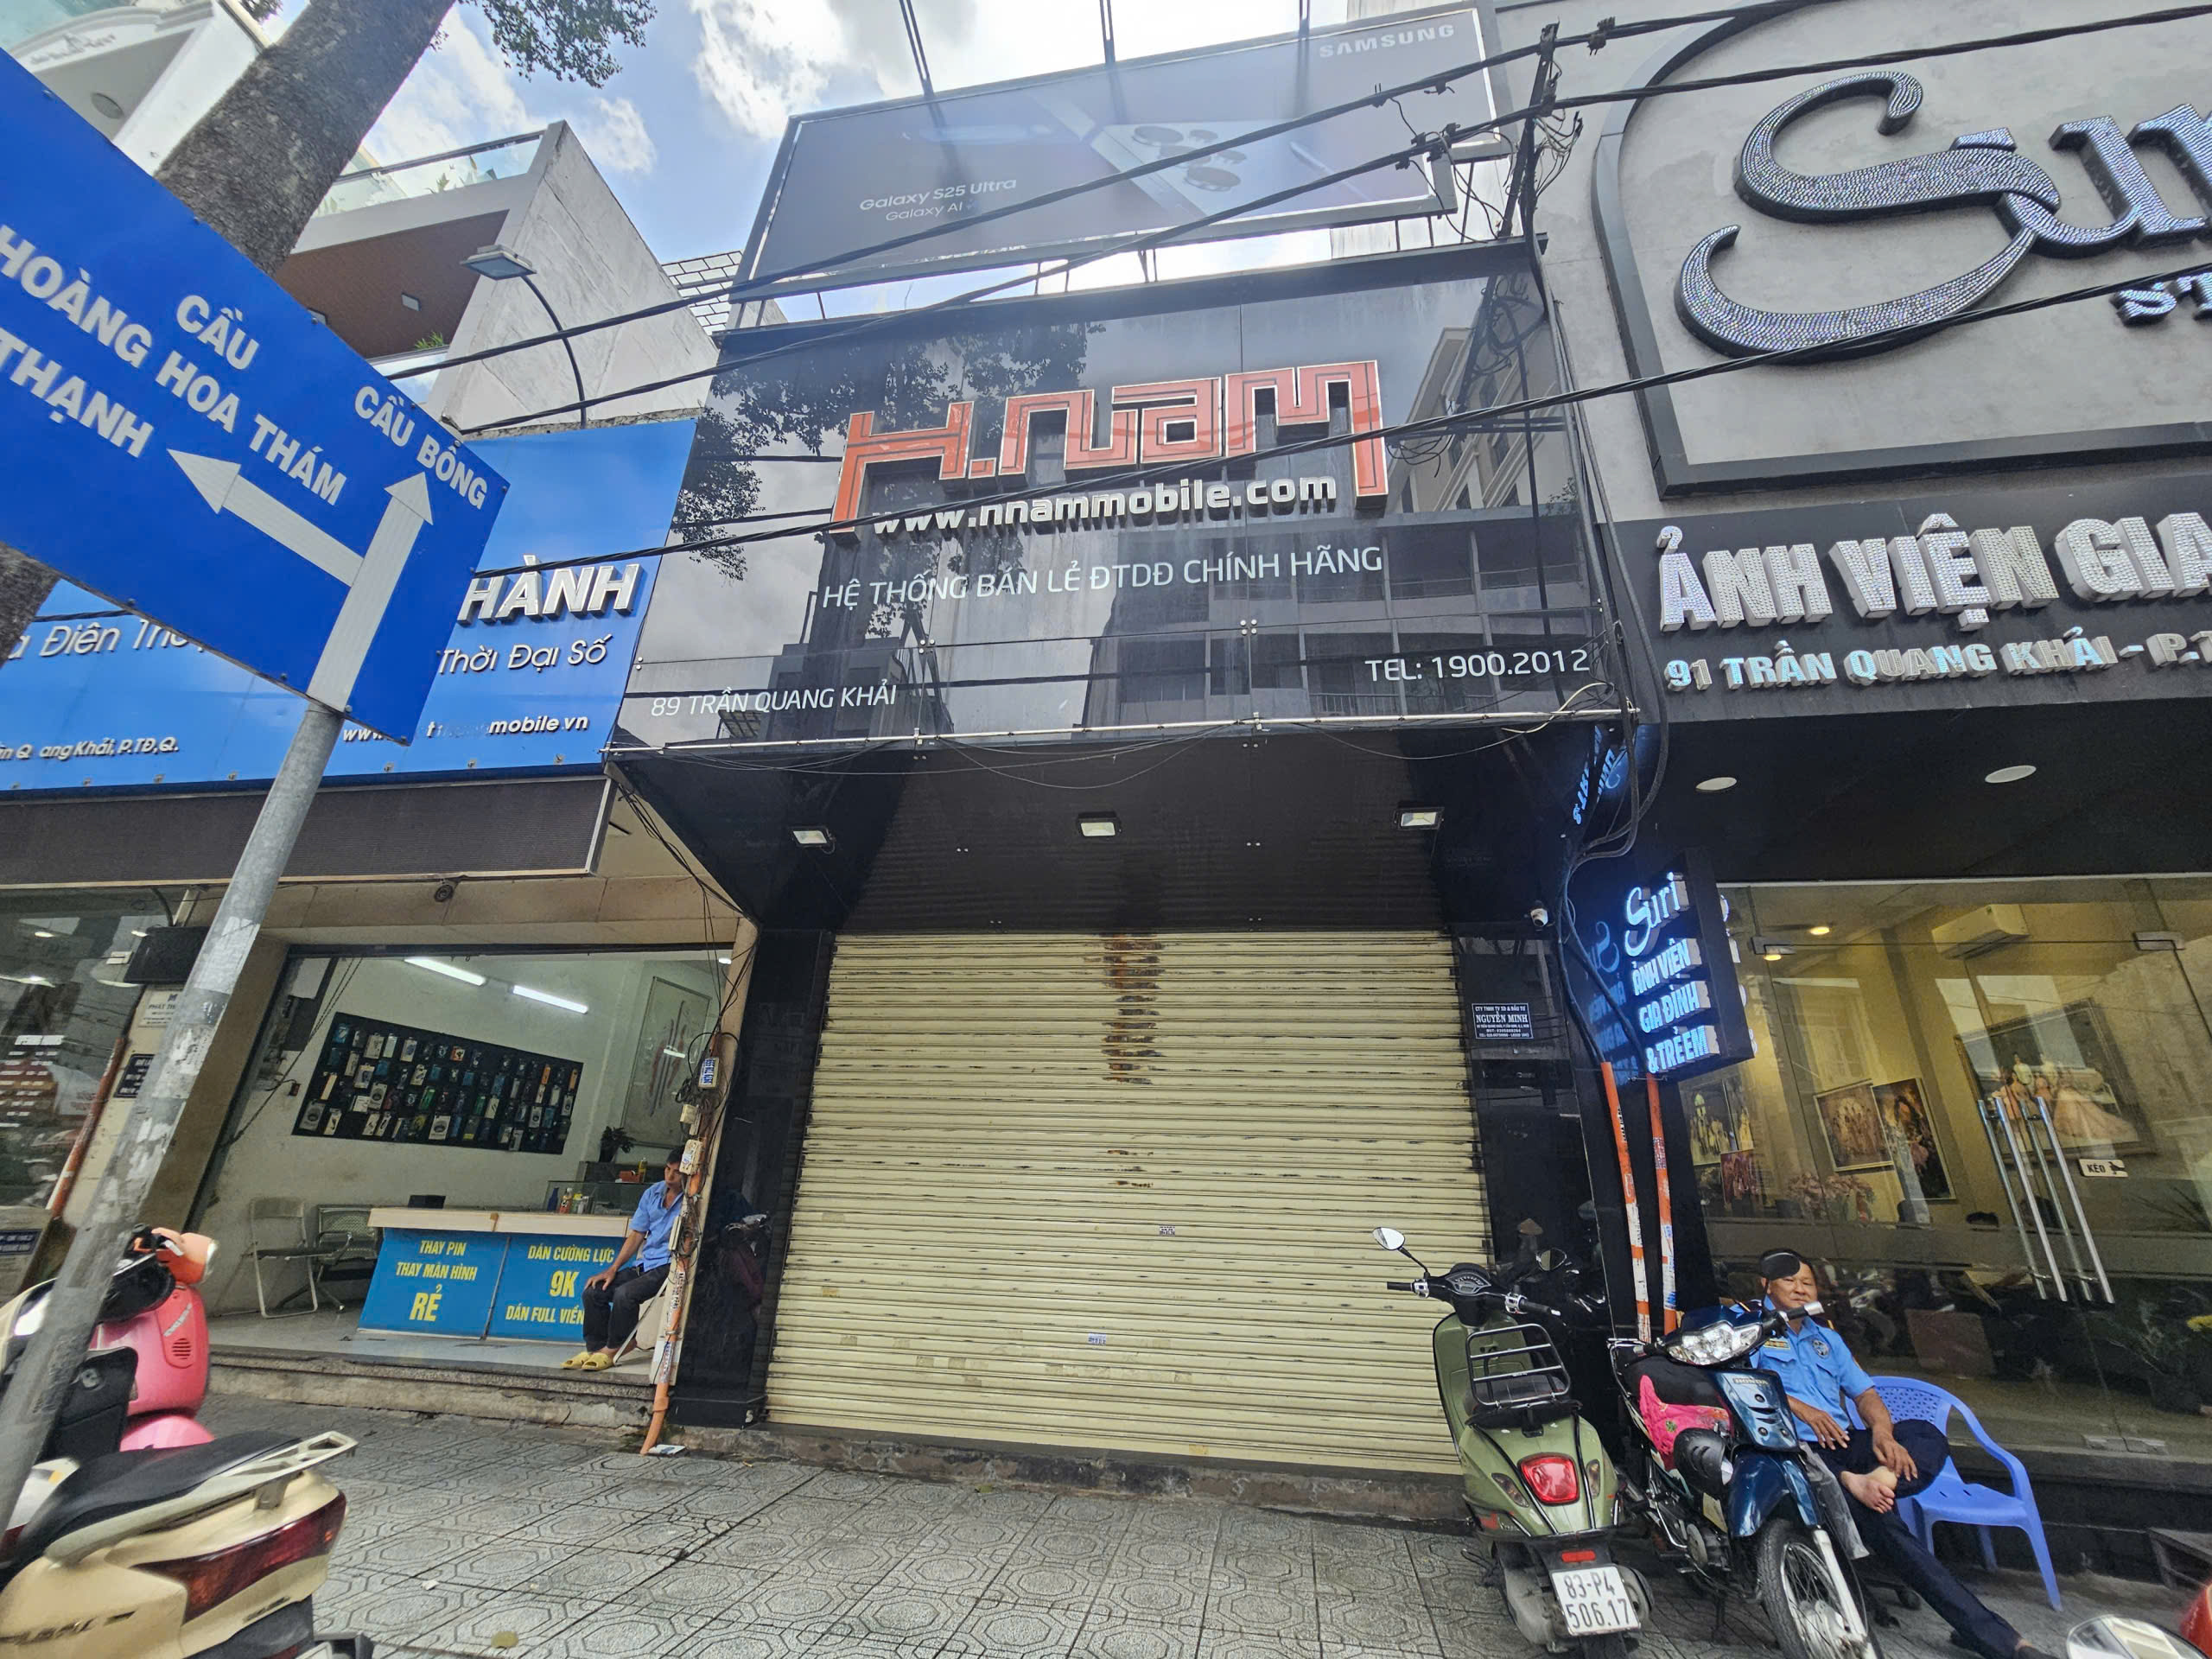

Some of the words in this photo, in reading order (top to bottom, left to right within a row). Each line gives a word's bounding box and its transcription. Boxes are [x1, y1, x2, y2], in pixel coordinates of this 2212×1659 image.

[1319, 24, 1454, 58] SAMSUNG
[859, 191, 930, 211] Galaxy
[932, 185, 966, 200] S25
[969, 179, 1017, 194] Ultra
[885, 206, 944, 221] Galaxy
[947, 201, 963, 213] AI
[176, 295, 259, 370] CẦU
[0, 225, 153, 369] HOÀNG
[156, 350, 240, 433] HOA
[248, 413, 347, 506] THÁM
[0, 327, 154, 458] THẠNH
[354, 385, 416, 447] CẦU
[416, 433, 488, 510] BÔNG
[457, 555, 645, 625] HÀNH
[823, 578, 861, 611] HỆ
[869, 569, 969, 605] THỐNG
[976, 567, 1038, 597] BÁN
[1047, 560, 1082, 592] LẺ
[1090, 562, 1173, 589] ĐTDĐ
[1184, 551, 1280, 584] CHÍNH
[1290, 544, 1382, 576] HÃNG
[1656, 525, 1834, 632] ẢNH
[1829, 512, 2060, 632] VIỆN
[439, 645, 499, 674] Thời
[508, 645, 561, 672] Đại
[567, 634, 613, 665] Số
[1364, 658, 1422, 682] TEL:
[1431, 649, 1590, 678] 1900.2012
[1664, 659, 1713, 692] 91
[1720, 639, 1838, 690] TRẦN
[1844, 644, 1998, 685] QUANG
[2000, 626, 2120, 677] KHẢI
[652, 696, 681, 717] 89
[688, 687, 748, 715] TRẦN
[754, 688, 836, 712] QUANG
[841, 678, 897, 707] KHẢI
[1624, 871, 1685, 957] Suri
[1631, 956, 1661, 995] ẢNH
[1657, 938, 1692, 978] VIỆN
[1507, 1014, 1529, 1023] MINH
[1639, 1001, 1659, 1033] GIA
[1661, 982, 1700, 1024] ĐÌNH
[1645, 1047, 1659, 1073] &
[1656, 1026, 1684, 1069] TRẺ
[1682, 1025, 1710, 1062] EM
[419, 1240, 446, 1255] THAY
[446, 1241, 467, 1255] PIN
[527, 1244, 553, 1262] DÁN
[396, 1262, 422, 1277] THAY
[449, 1262, 478, 1281] HÌNH
[549, 1269, 580, 1298] 9K
[409, 1283, 442, 1322] RẺ
[505, 1304, 530, 1322] DÁN
[531, 1306, 556, 1323] FULL
[1563, 1570, 1616, 1599] 83-P4
[1566, 1598, 1630, 1630] 506.17
